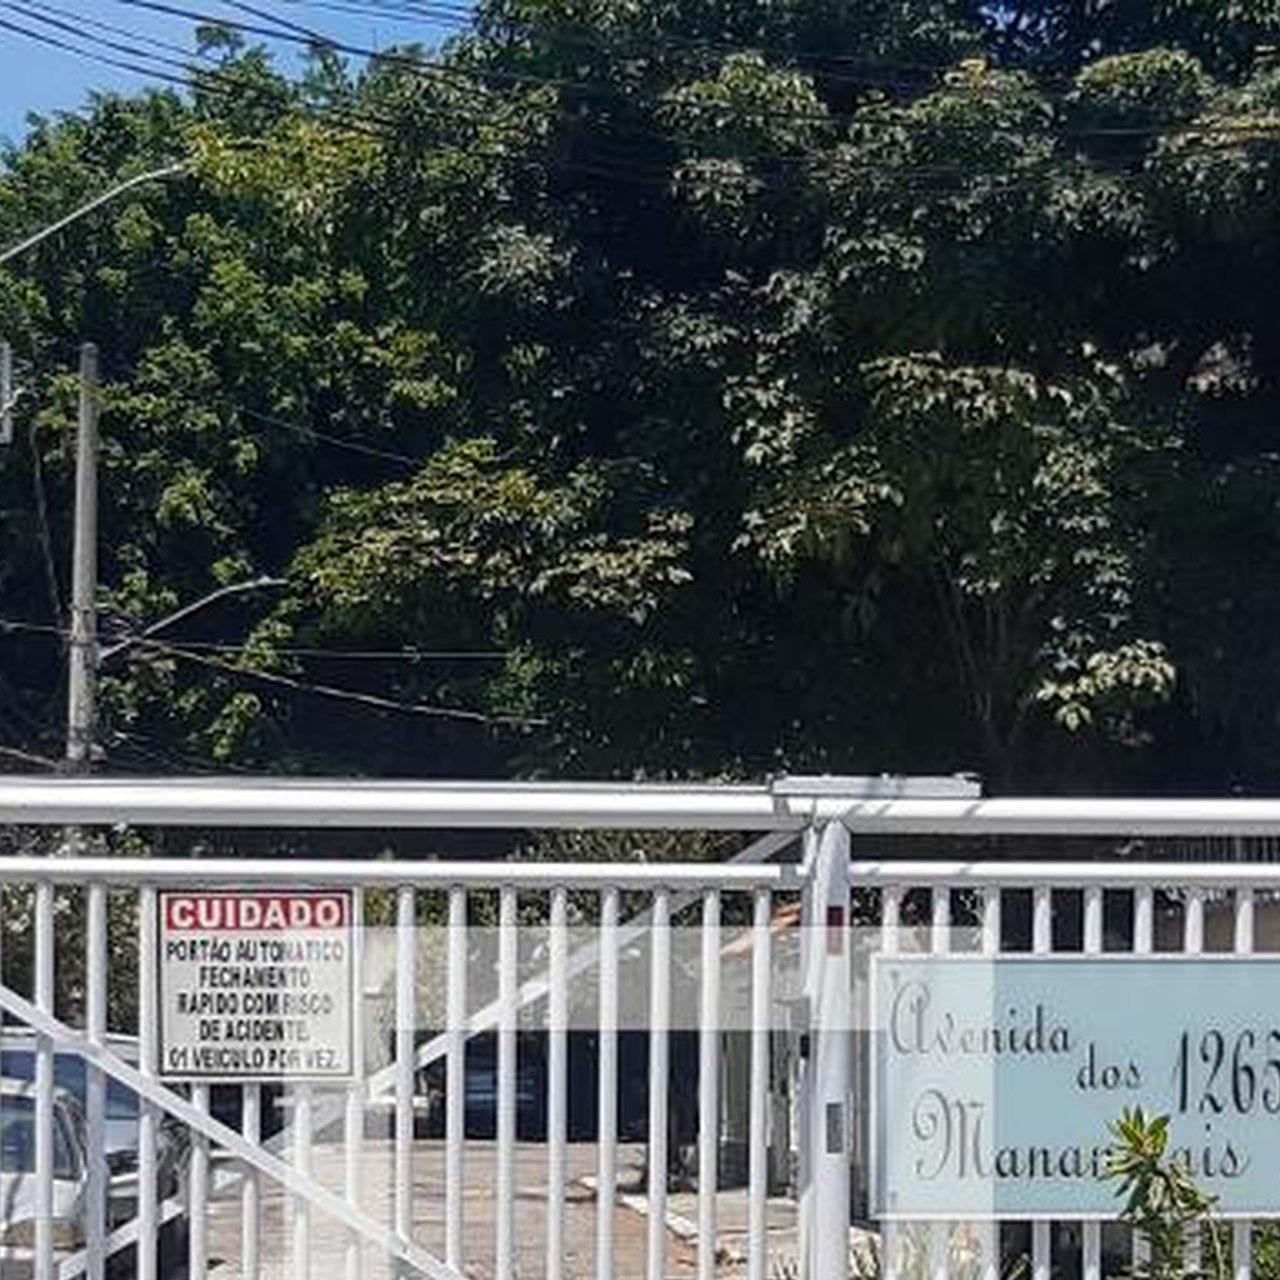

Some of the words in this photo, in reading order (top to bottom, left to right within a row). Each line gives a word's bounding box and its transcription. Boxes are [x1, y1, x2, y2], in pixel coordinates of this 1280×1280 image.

[170, 898, 341, 928] CUIDADO
[198, 966, 311, 988] FECHAMENTO
[242, 992, 280, 1015] COM
[283, 993, 335, 1015] RISCO
[199, 1019, 221, 1042] DE
[890, 979, 1070, 1056] Avenida
[268, 1047, 301, 1069] POR
[1075, 1043, 1143, 1091] dos
[912, 1088, 1252, 1181] Manaais
